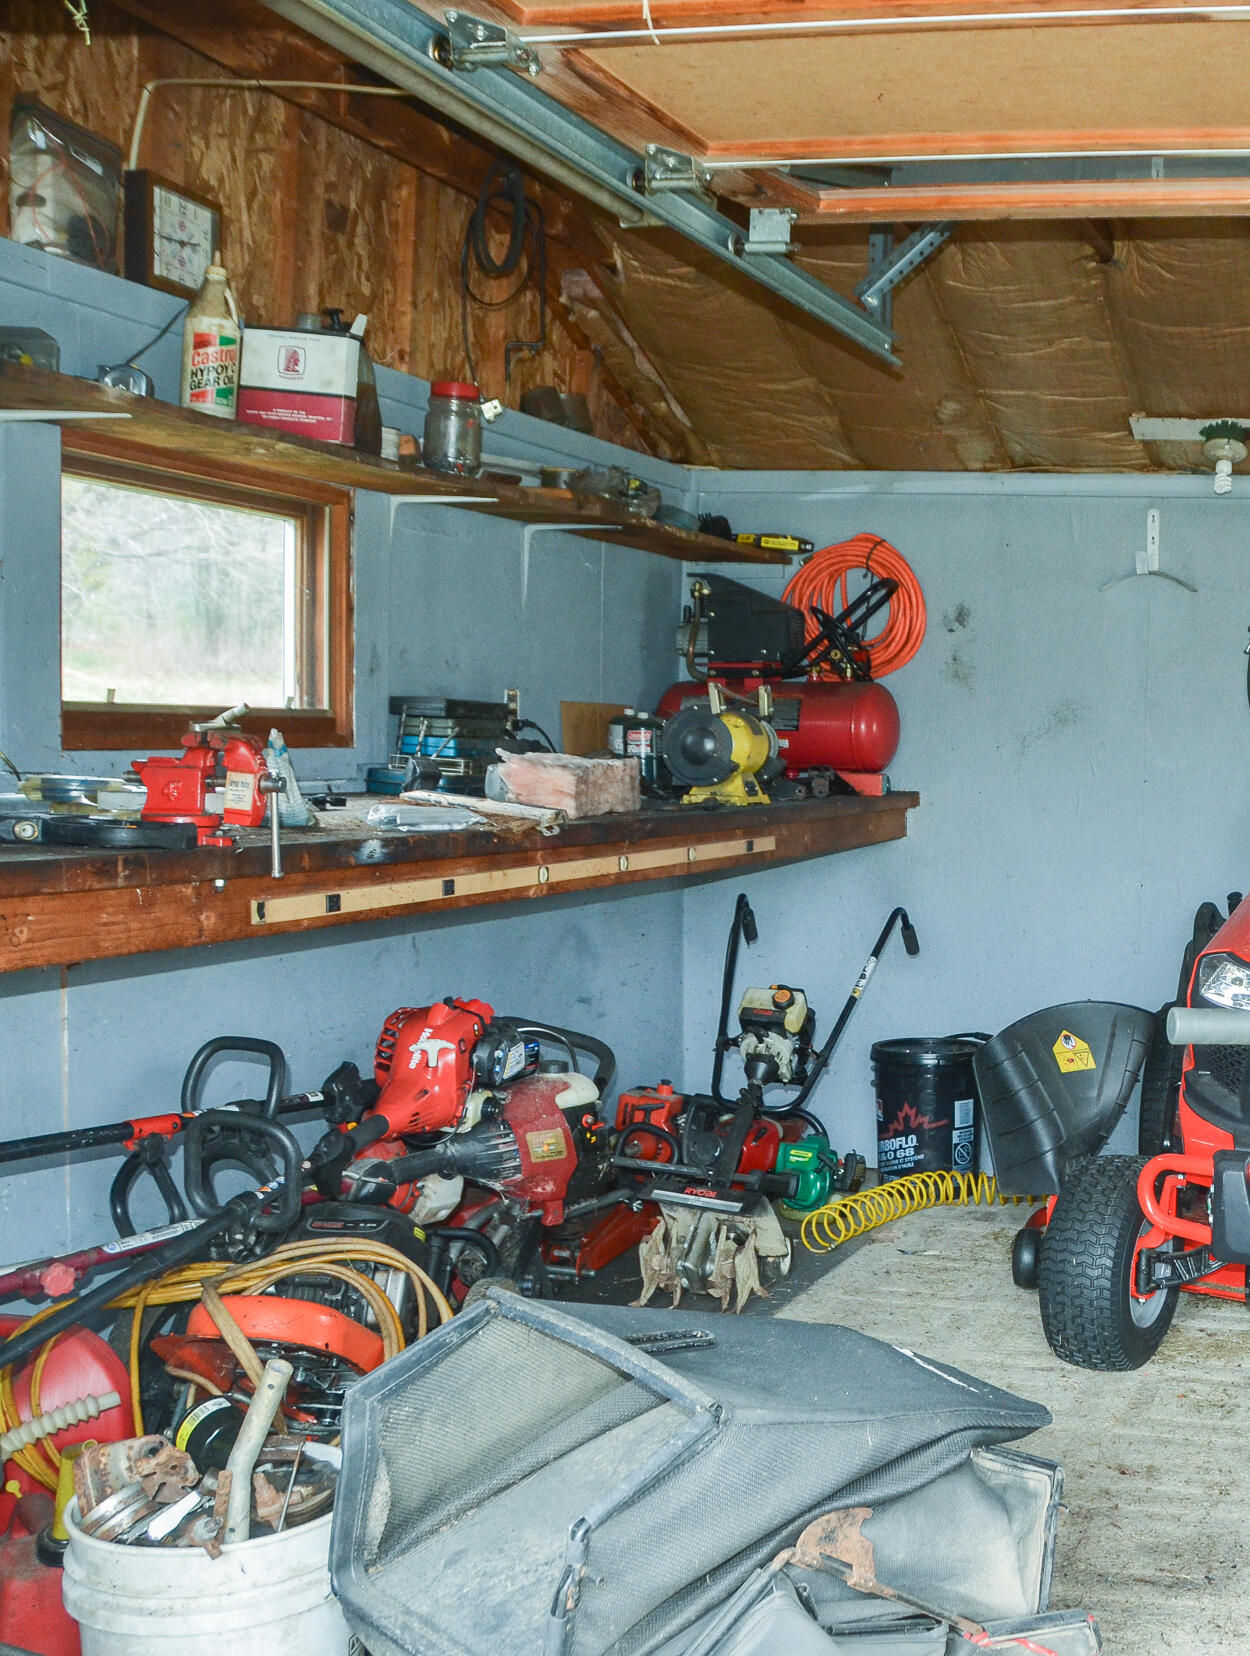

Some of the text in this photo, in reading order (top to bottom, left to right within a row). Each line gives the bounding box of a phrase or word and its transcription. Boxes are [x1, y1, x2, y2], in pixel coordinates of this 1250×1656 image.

[189, 376, 220, 391] GEAR
[880, 1134, 917, 1152] RBOFLO
[896, 1147, 915, 1158] 68
